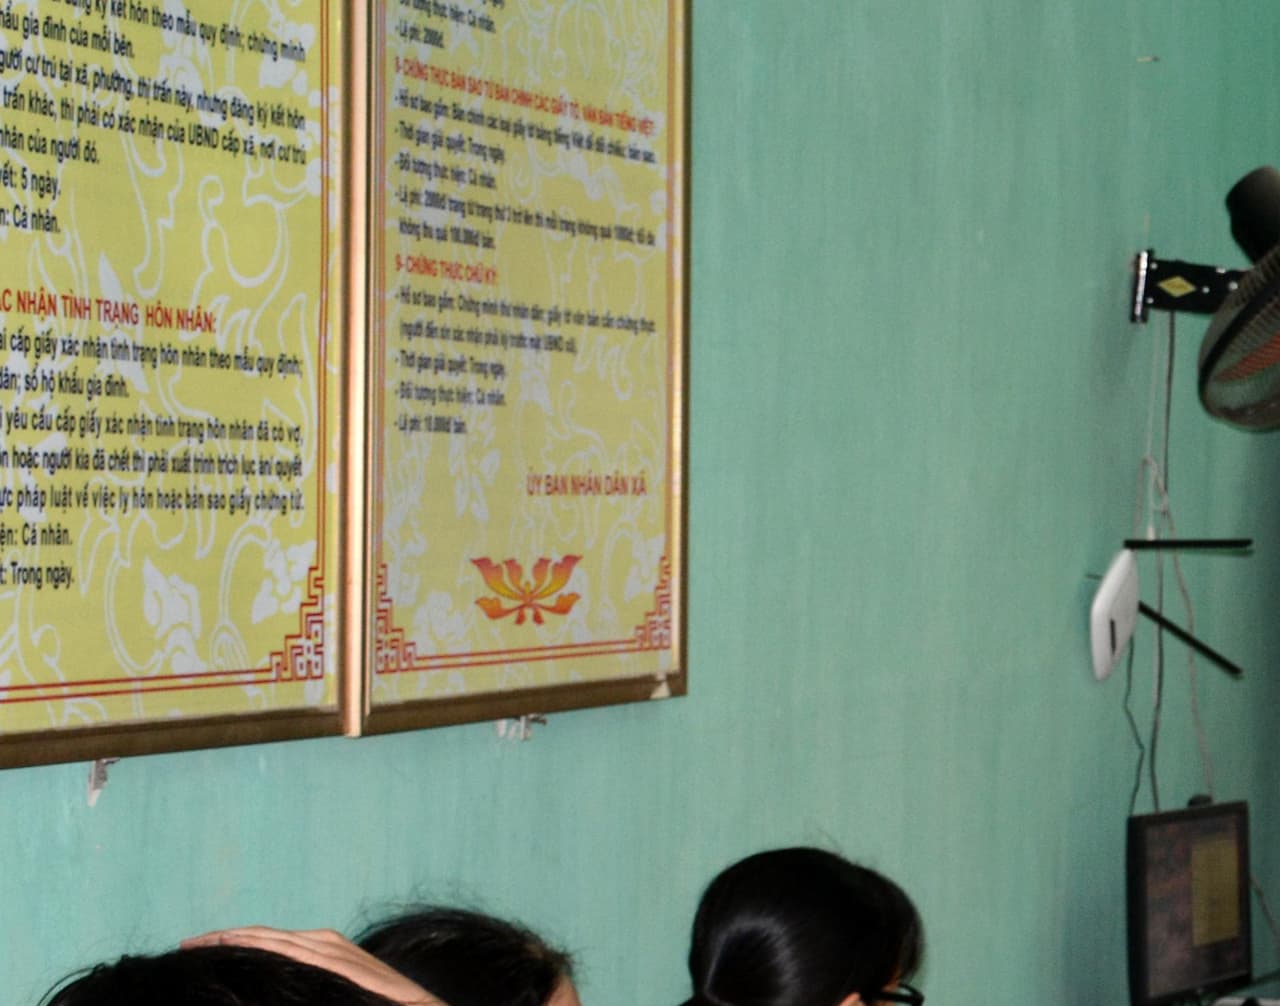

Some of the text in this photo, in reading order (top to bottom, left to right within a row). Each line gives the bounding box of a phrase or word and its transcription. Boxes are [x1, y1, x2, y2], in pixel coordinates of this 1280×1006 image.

[22, 11, 39, 40] gia
[69, 20, 88, 47] của
[113, 32, 135, 59] bên.
[25, 56, 40, 74] cư
[42, 55, 57, 79] trú
[59, 59, 73, 88] tại
[75, 64, 90, 89] xã,
[93, 68, 134, 101] phường,
[152, 78, 172, 105] trấn
[197, 90, 228, 121] nhưng
[230, 96, 254, 126] đăng
[271, 102, 285, 127] kết
[287, 107, 305, 131] hôn
[3, 83, 25, 111] trấn
[28, 90, 57, 122] khác,
[77, 100, 100, 128] phải
[102, 106, 115, 130] có
[118, 111, 136, 134] xác
[139, 115, 164, 145] nhận
[167, 118, 185, 143] của
[188, 123, 219, 149] UBND
[222, 128, 240, 158] cấp
[243, 134, 257, 159] xã,
[260, 138, 275, 160] nơi
[278, 143, 291, 162] cư
[292, 143, 306, 165] trú
[28, 128, 47, 154] của
[50, 136, 80, 164] người
[84, 140, 100, 164] đó.
[21, 166, 28, 190] 5
[13, 204, 28, 229] Cá
[31, 207, 61, 234] nhân.
[17, 287, 57, 321] NHẬN
[61, 289, 91, 321] TÌNH
[96, 299, 139, 329] TRẠNG
[146, 299, 173, 328] HÔN
[176, 305, 216, 333] NHÂN:
[10, 326, 31, 358] cấp
[34, 328, 57, 360] giấy
[61, 333, 80, 357] xác
[83, 336, 109, 365] nhận
[132, 341, 157, 369] trạng
[160, 342, 179, 365] hôn
[182, 345, 207, 367] nhân
[210, 348, 231, 370] theo
[234, 345, 255, 371] mẫu
[257, 355, 275, 379] quy
[41, 369, 55, 400] hộ
[58, 366, 83, 395] khẩu
[87, 374, 102, 401] gia
[6, 406, 27, 435] yêu
[56, 406, 75, 437] cấp
[79, 407, 101, 439] giấy
[106, 411, 124, 434] xác
[127, 413, 153, 442] nhận
[178, 417, 204, 444] trạng
[207, 417, 226, 439] hôn
[229, 419, 254, 440] nhân
[257, 420, 268, 442] đã
[272, 420, 284, 442] có
[22, 522, 37, 546] Cá
[41, 522, 73, 546] nhân.
[10, 560, 42, 590] Trong
